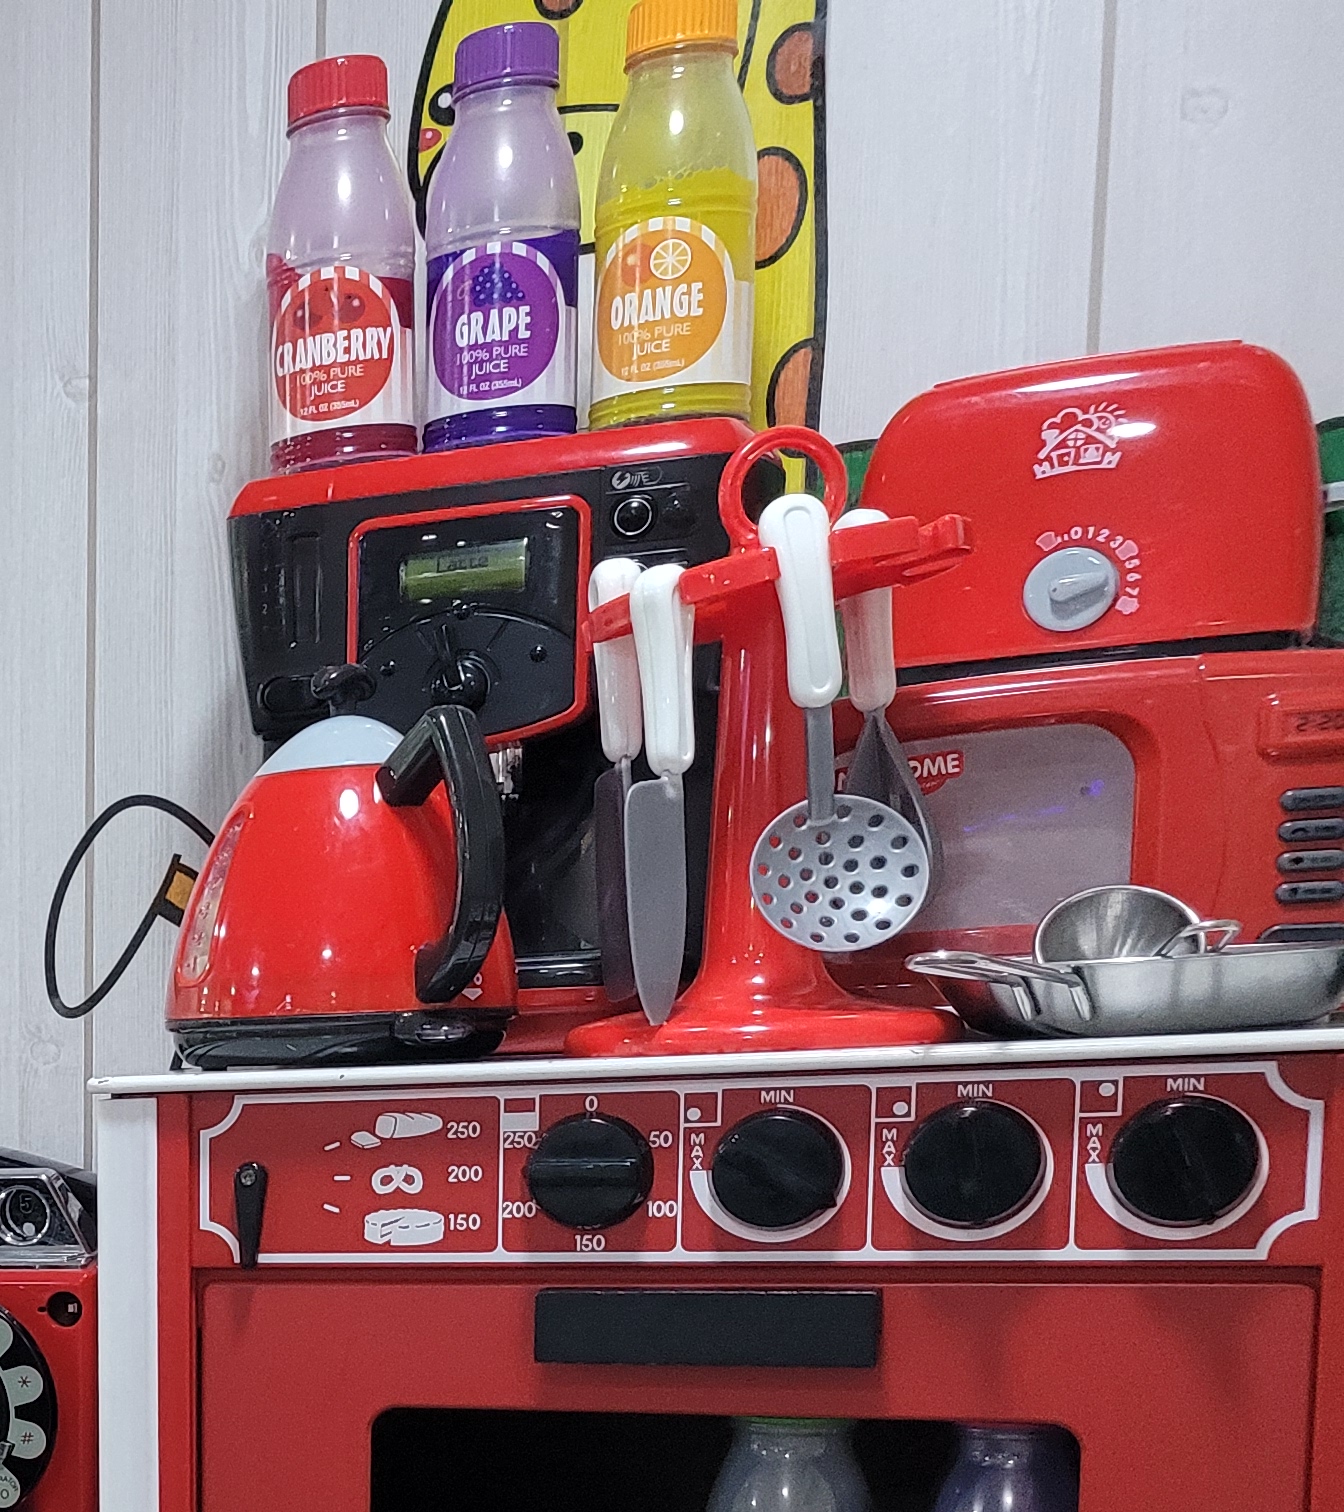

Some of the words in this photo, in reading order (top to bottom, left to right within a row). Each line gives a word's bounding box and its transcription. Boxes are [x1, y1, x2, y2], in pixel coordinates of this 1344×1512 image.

[610, 281, 704, 331] ORANGE
[455, 304, 532, 348] GRAPE
[618, 328, 651, 346] 100%
[654, 322, 692, 339] PURE
[275, 325, 392, 377] CRANBERRY
[456, 348, 490, 366] 100%
[492, 343, 529, 359] PURE
[632, 339, 671, 361] JUICE
[296, 370, 327, 386] 100%
[330, 364, 366, 380] PURE
[470, 359, 509, 380] JUICE
[309, 379, 346, 400] JUICE
[1087, 526, 1096, 540] 1
[1096, 528, 1111, 543] 2
[1124, 586, 1140, 596] 7
[957, 1082, 994, 1099] MIN
[1166, 1075, 1205, 1094] MIN
[583, 1095, 599, 1113] 0
[760, 1089, 795, 1105] MIN
[446, 1120, 481, 1139] 250
[503, 1130, 537, 1149] 250
[648, 1131, 673, 1149] 50
[689, 1132, 705, 1171] MAX
[881, 1127, 897, 1167] MAX
[1085, 1122, 1103, 1164] MAX
[447, 1164, 483, 1184] 200
[19, 1193, 34, 1214] 5
[502, 1200, 537, 1219] 200
[646, 1200, 678, 1219] 100
[447, 1212, 482, 1232] 150
[574, 1233, 607, 1253] 150
[0, 1488, 10, 1500] 0
